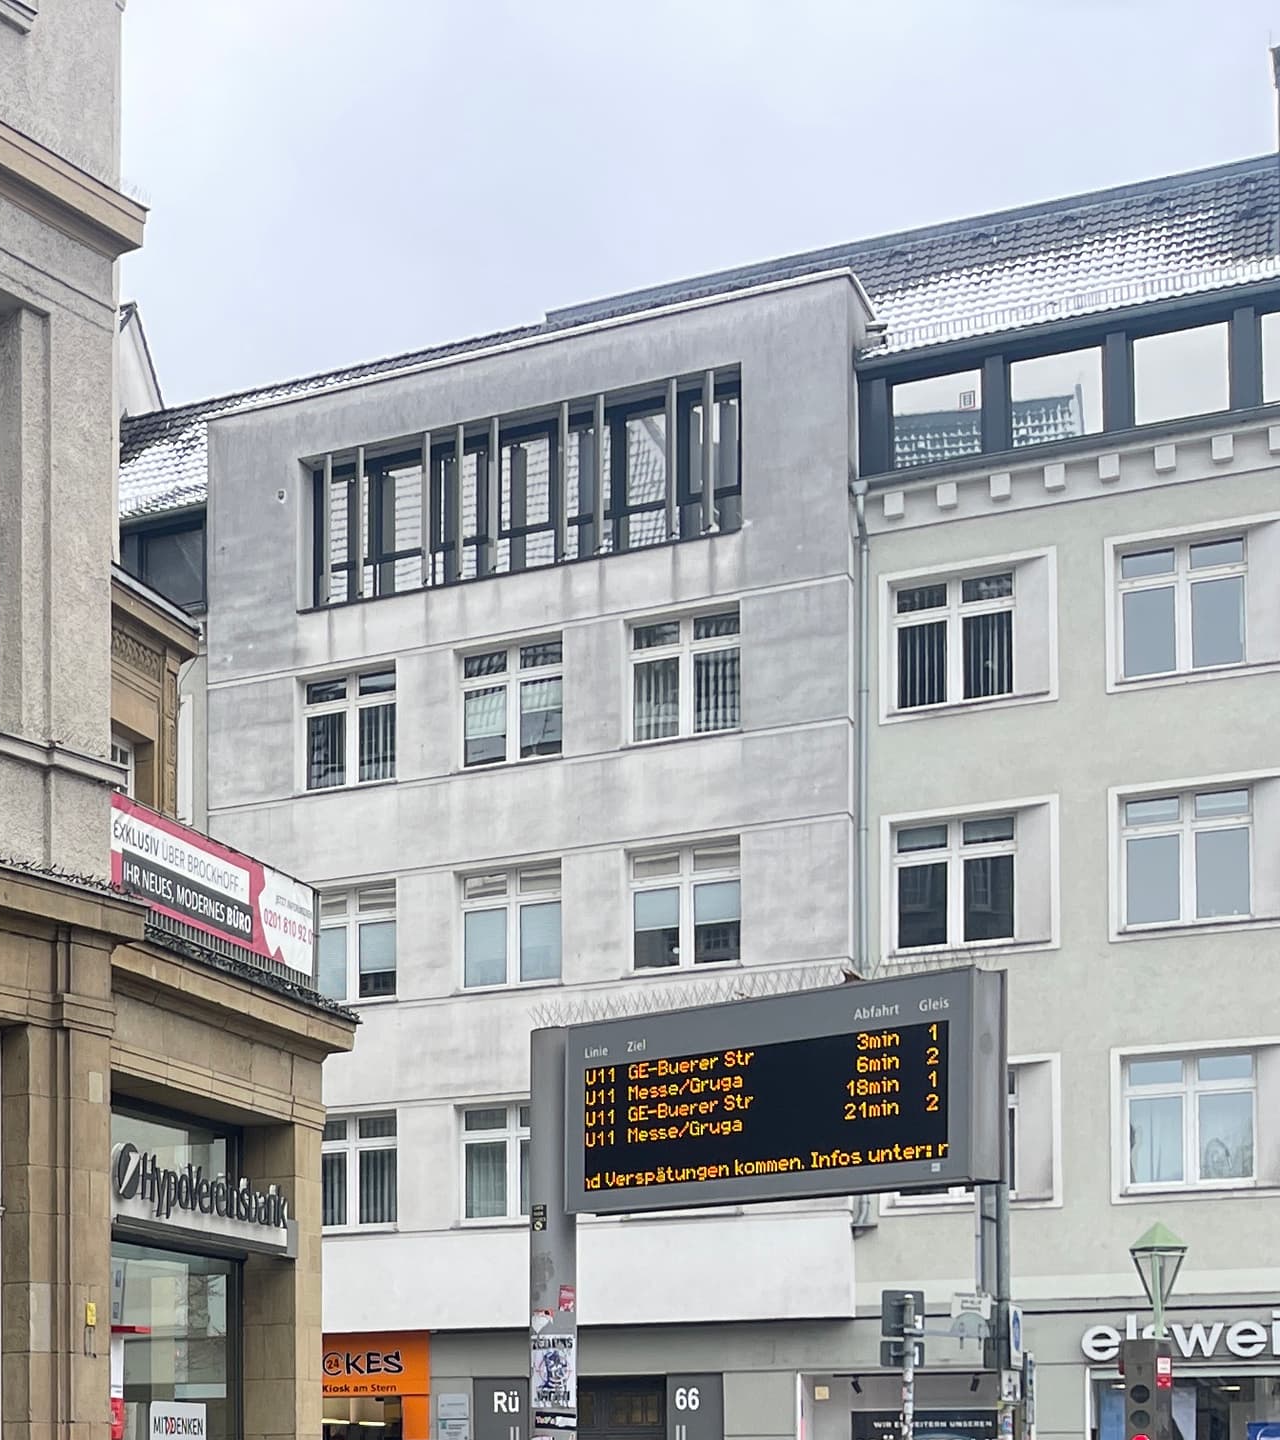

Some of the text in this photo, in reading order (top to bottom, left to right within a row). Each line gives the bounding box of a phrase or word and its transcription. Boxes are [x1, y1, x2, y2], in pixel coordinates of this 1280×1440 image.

[113, 820, 159, 857] EXKLUSIV
[161, 840, 185, 869] ÜBER
[188, 855, 239, 891] BROCKHOFF
[123, 861, 140, 885] IHR
[143, 871, 174, 904] NEUES,
[176, 884, 225, 921] MODERNES
[226, 905, 251, 934] BÜRO
[584, 997, 949, 1058] Linie Ziel Abfahrt Gleis
[586, 1025, 938, 1085] U11 GE-Buerer Str 3min 1
[586, 1048, 939, 1106] U11 Messe/Gruga 6min 2
[586, 1071, 938, 1127] U11 GE-Buerer Str 18min 1
[586, 1094, 939, 1148] U11 Messe/Gruga 21min 2
[141, 1152, 288, 1229] HypoVereinsbank
[605, 1163, 729, 1187] Verspätungen
[734, 1155, 806, 1176] kommen.
[810, 1150, 862, 1169] Infos
[868, 1145, 933, 1163] unter:
[1081, 1310, 1280, 1361] elwei
[322, 1384, 351, 1393] Kiosk
[371, 1384, 397, 1392] Stern
[675, 1388, 700, 1411] 66
[873, 1421, 891, 1429] WIR
